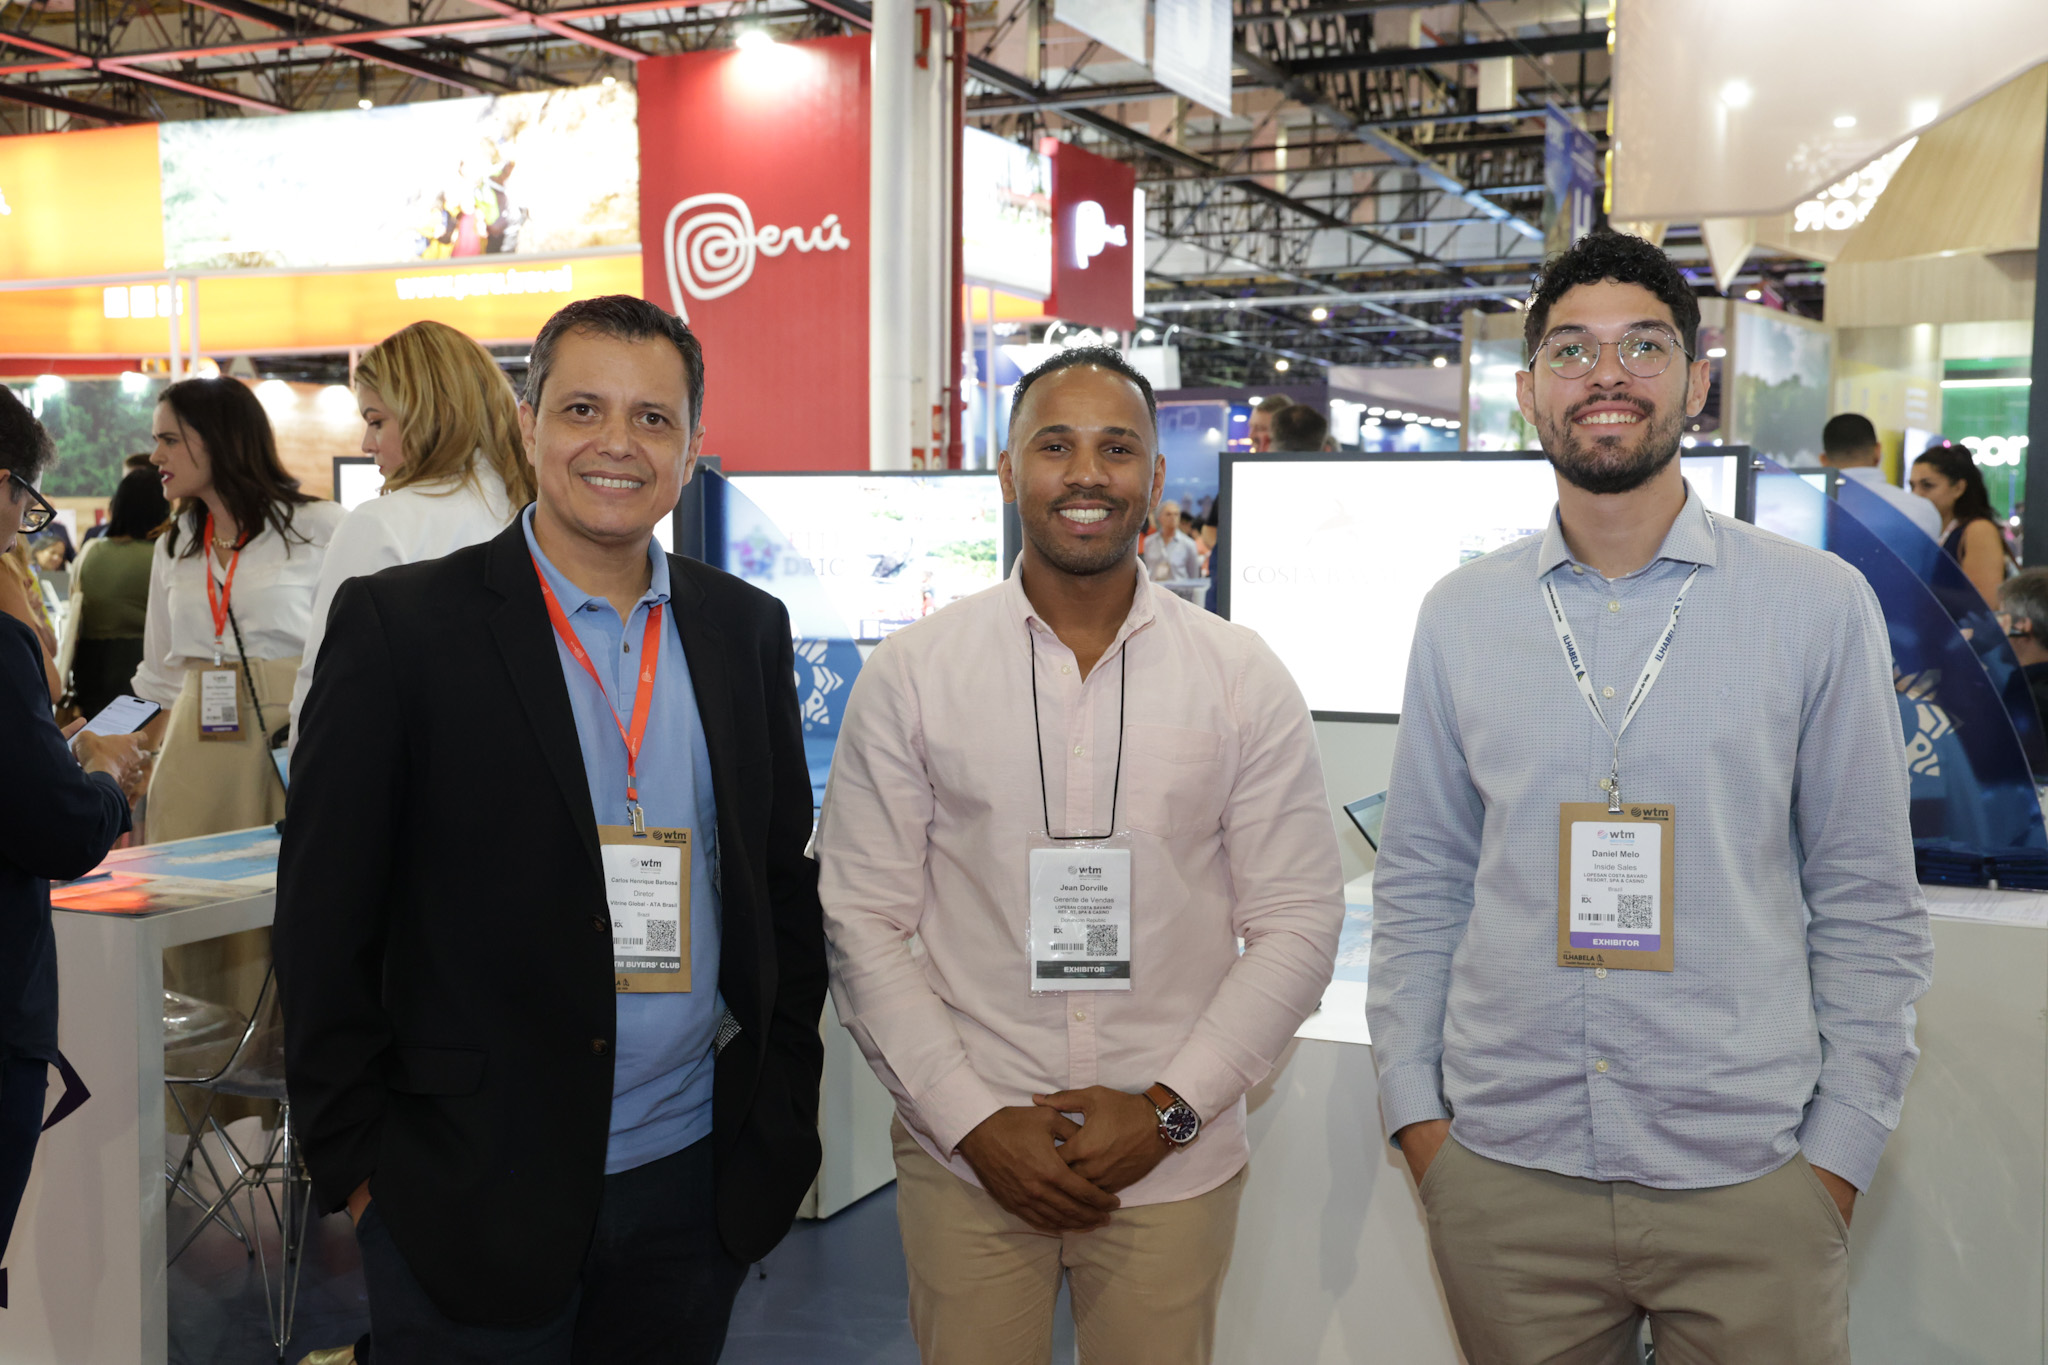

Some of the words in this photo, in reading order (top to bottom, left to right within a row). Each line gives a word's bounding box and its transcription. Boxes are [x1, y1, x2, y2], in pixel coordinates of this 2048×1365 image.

[664, 193, 850, 325] Perú
[1563, 634, 1581, 671] ILHABELA
[1643, 807, 1668, 817] wtm
[664, 831, 687, 840] wtm
[1609, 830, 1635, 839] wtm
[1592, 849, 1618, 858] Daniel
[1620, 850, 1640, 858] Melo
[640, 859, 662, 868] wtm
[1594, 863, 1616, 871] Inside
[1079, 866, 1102, 874] wtm
[629, 878, 654, 886] Henrique
[1080, 884, 1108, 892] Dorville
[633, 890, 655, 898] Diretor
[1593, 938, 1640, 947] EXHIBITOR
[1563, 953, 1595, 962] ILHABELA
[626, 961, 658, 969] BUYERS'
